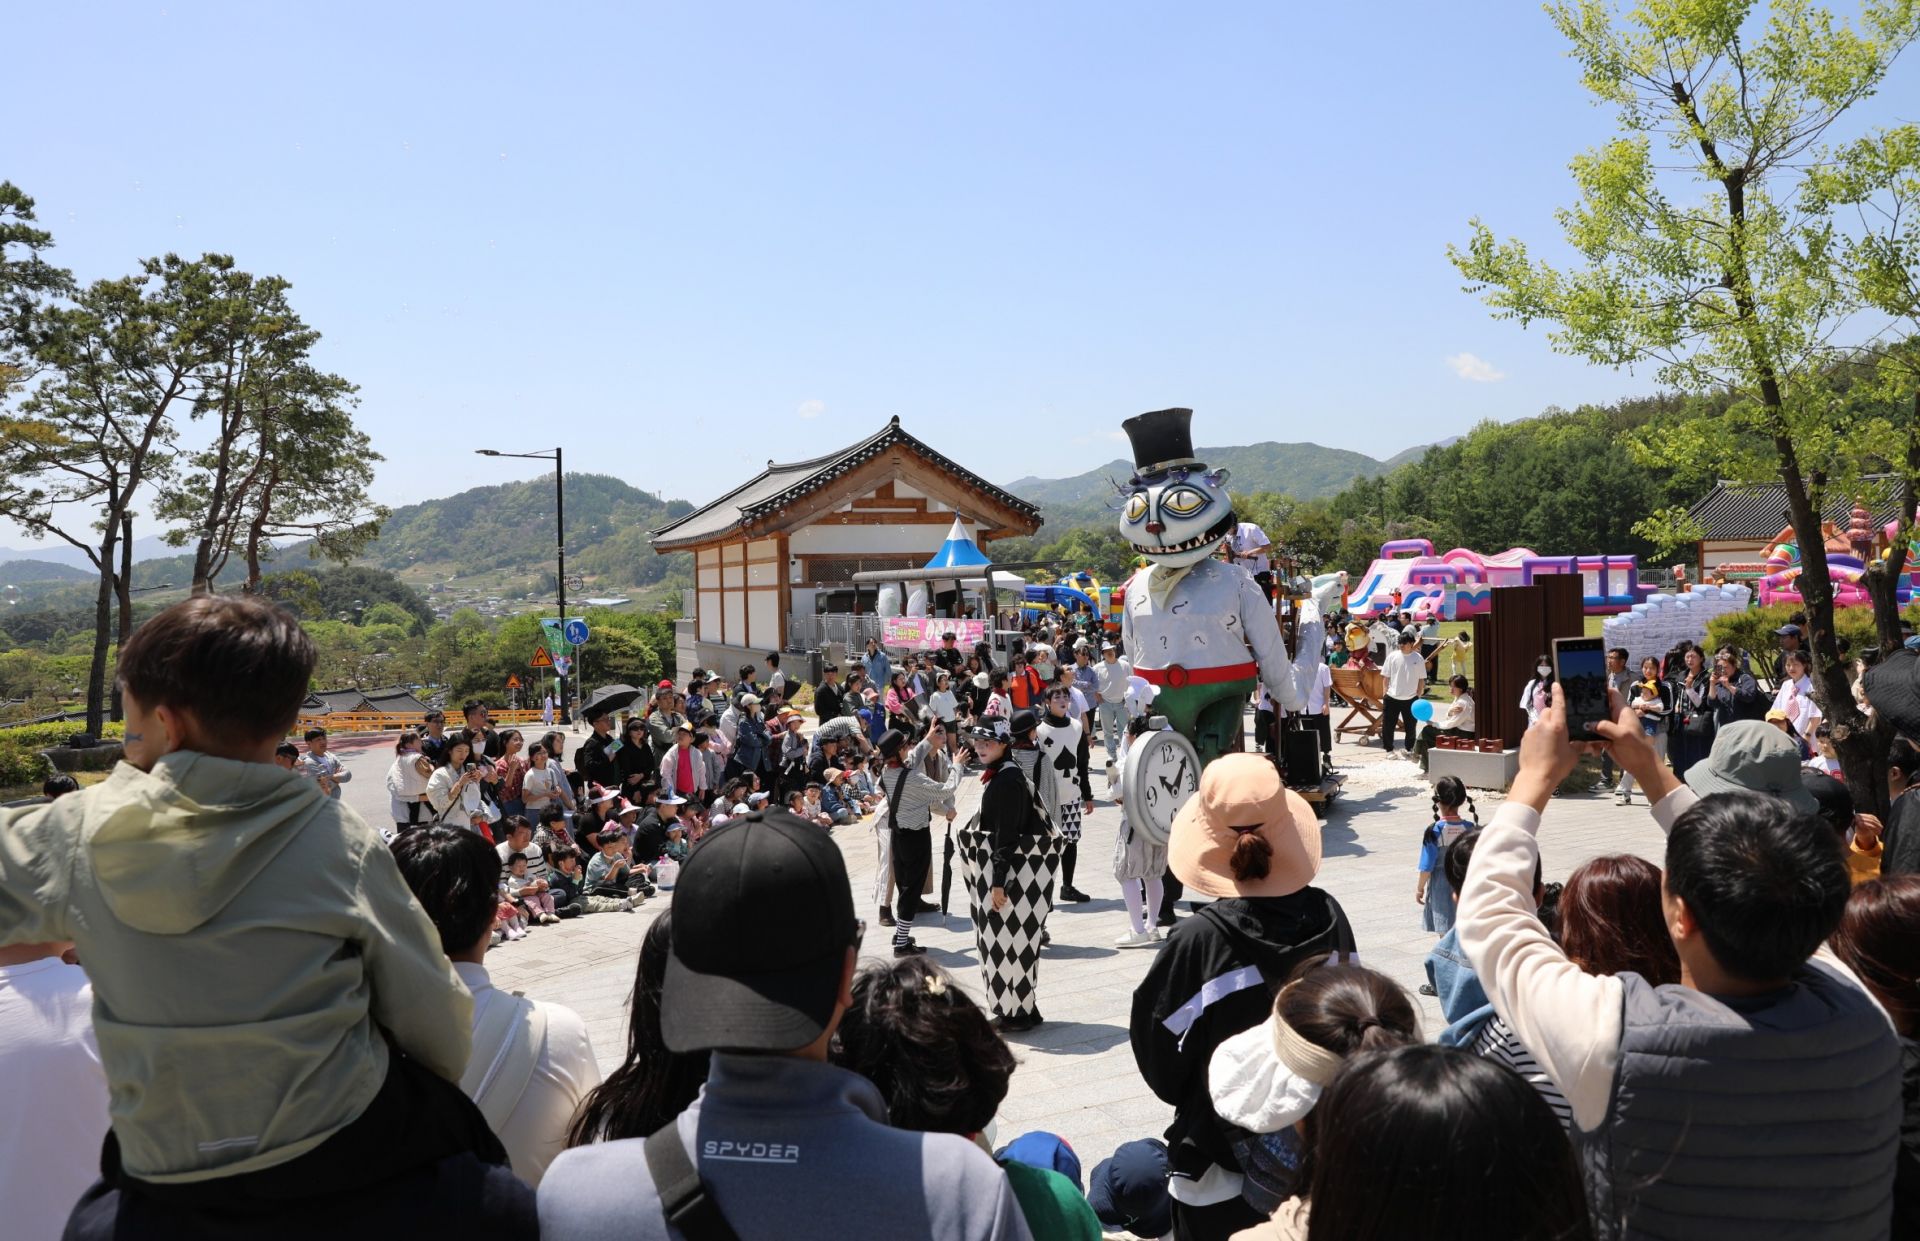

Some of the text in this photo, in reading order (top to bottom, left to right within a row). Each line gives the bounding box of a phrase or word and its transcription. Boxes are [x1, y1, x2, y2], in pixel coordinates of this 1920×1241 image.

[1160, 744, 1175, 765] 12
[1186, 773, 1195, 793] 3
[1146, 785, 1158, 808] 9
[704, 1140, 799, 1158] SPYDER
